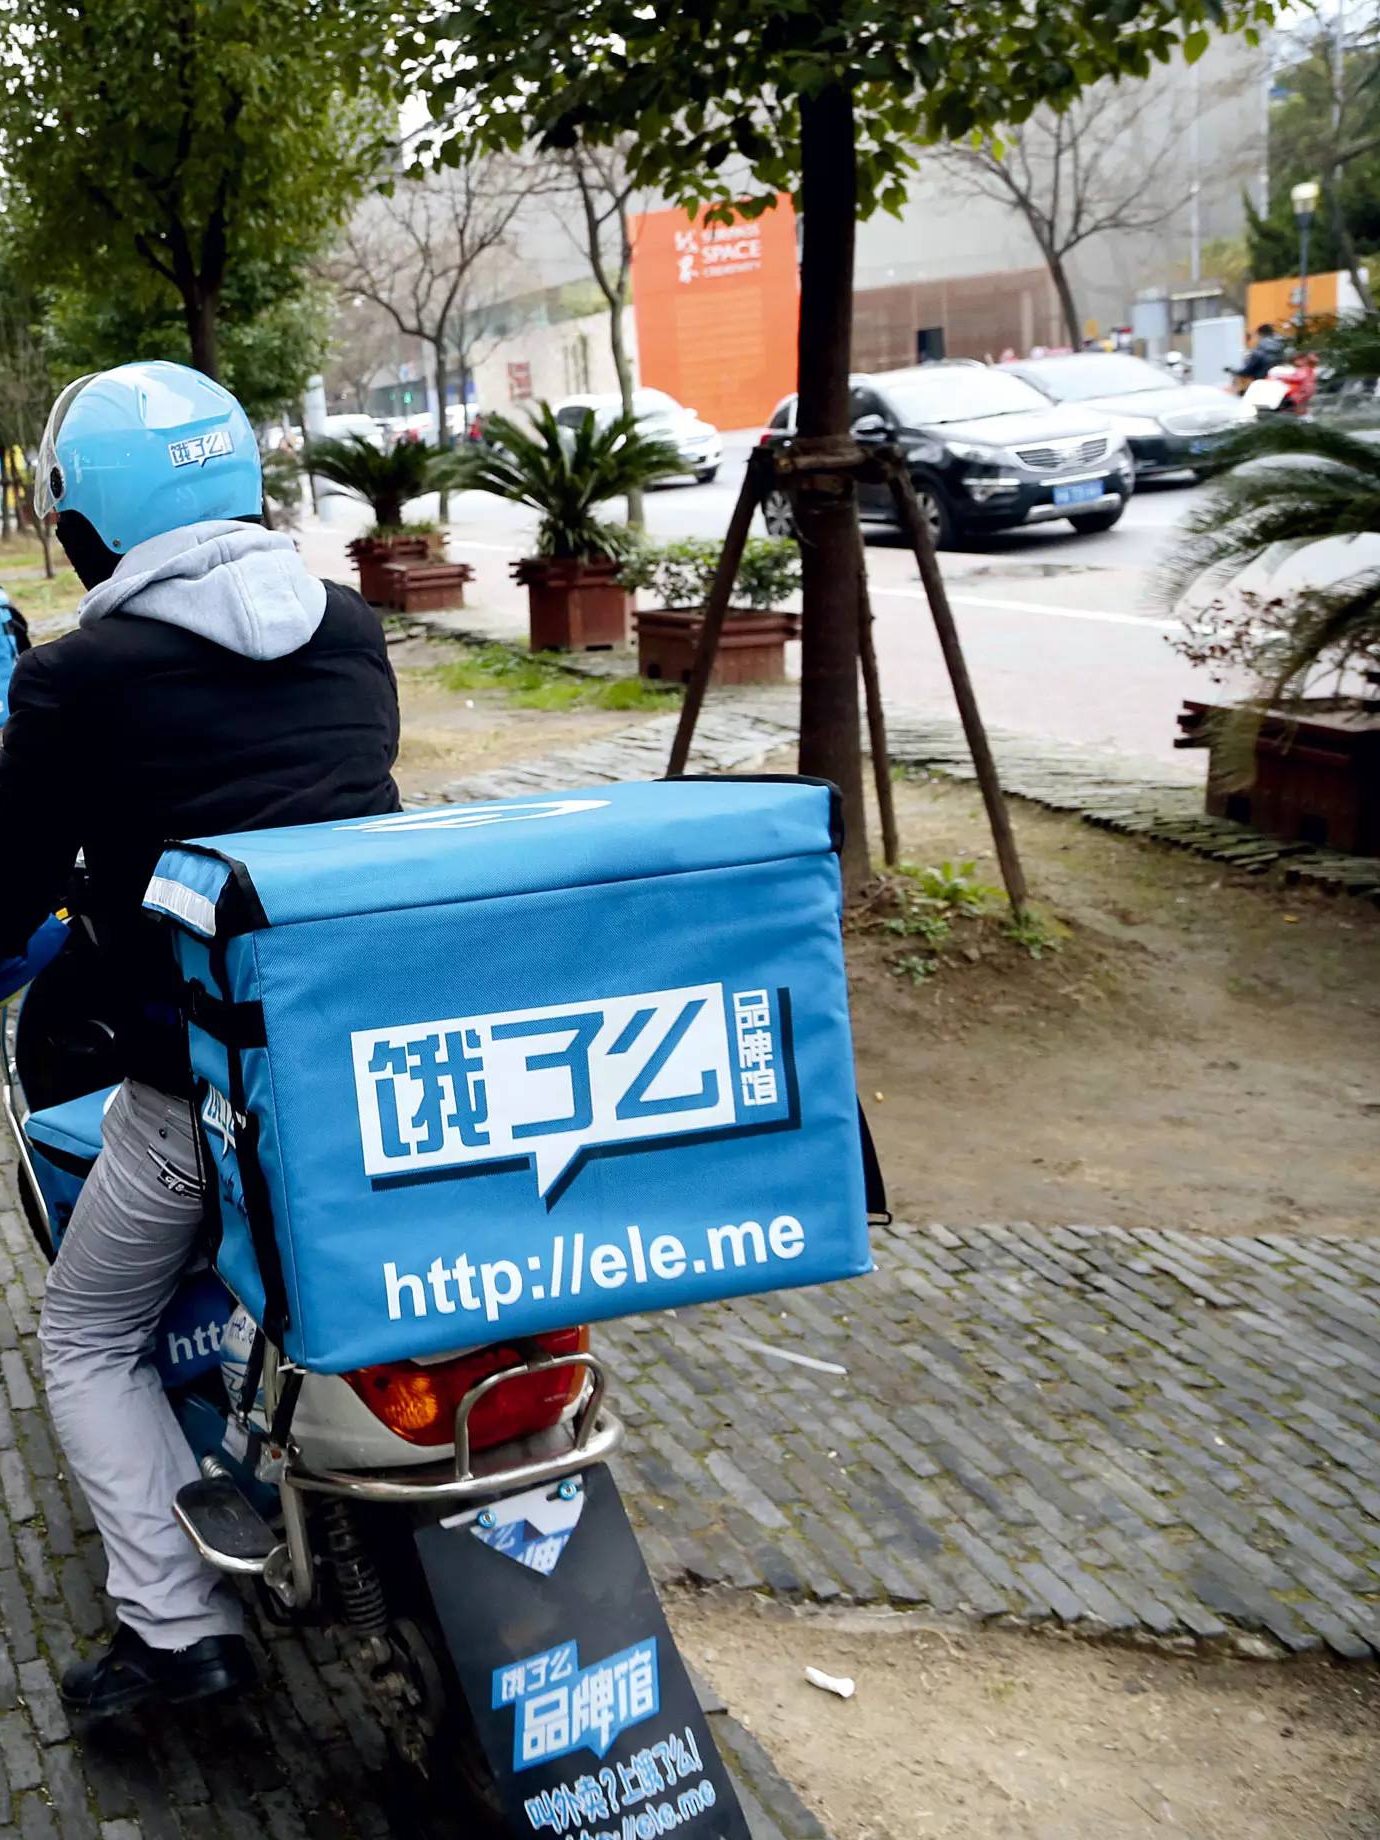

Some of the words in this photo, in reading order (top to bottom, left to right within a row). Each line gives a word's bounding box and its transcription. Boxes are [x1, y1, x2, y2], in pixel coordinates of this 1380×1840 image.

[701, 240, 761, 264] SPACE
[366, 996, 720, 1158] 饿了么
[383, 1213, 806, 1323] http://ele.me
[167, 1320, 226, 1365] htt
[522, 1649, 654, 1762] 品牌馆
